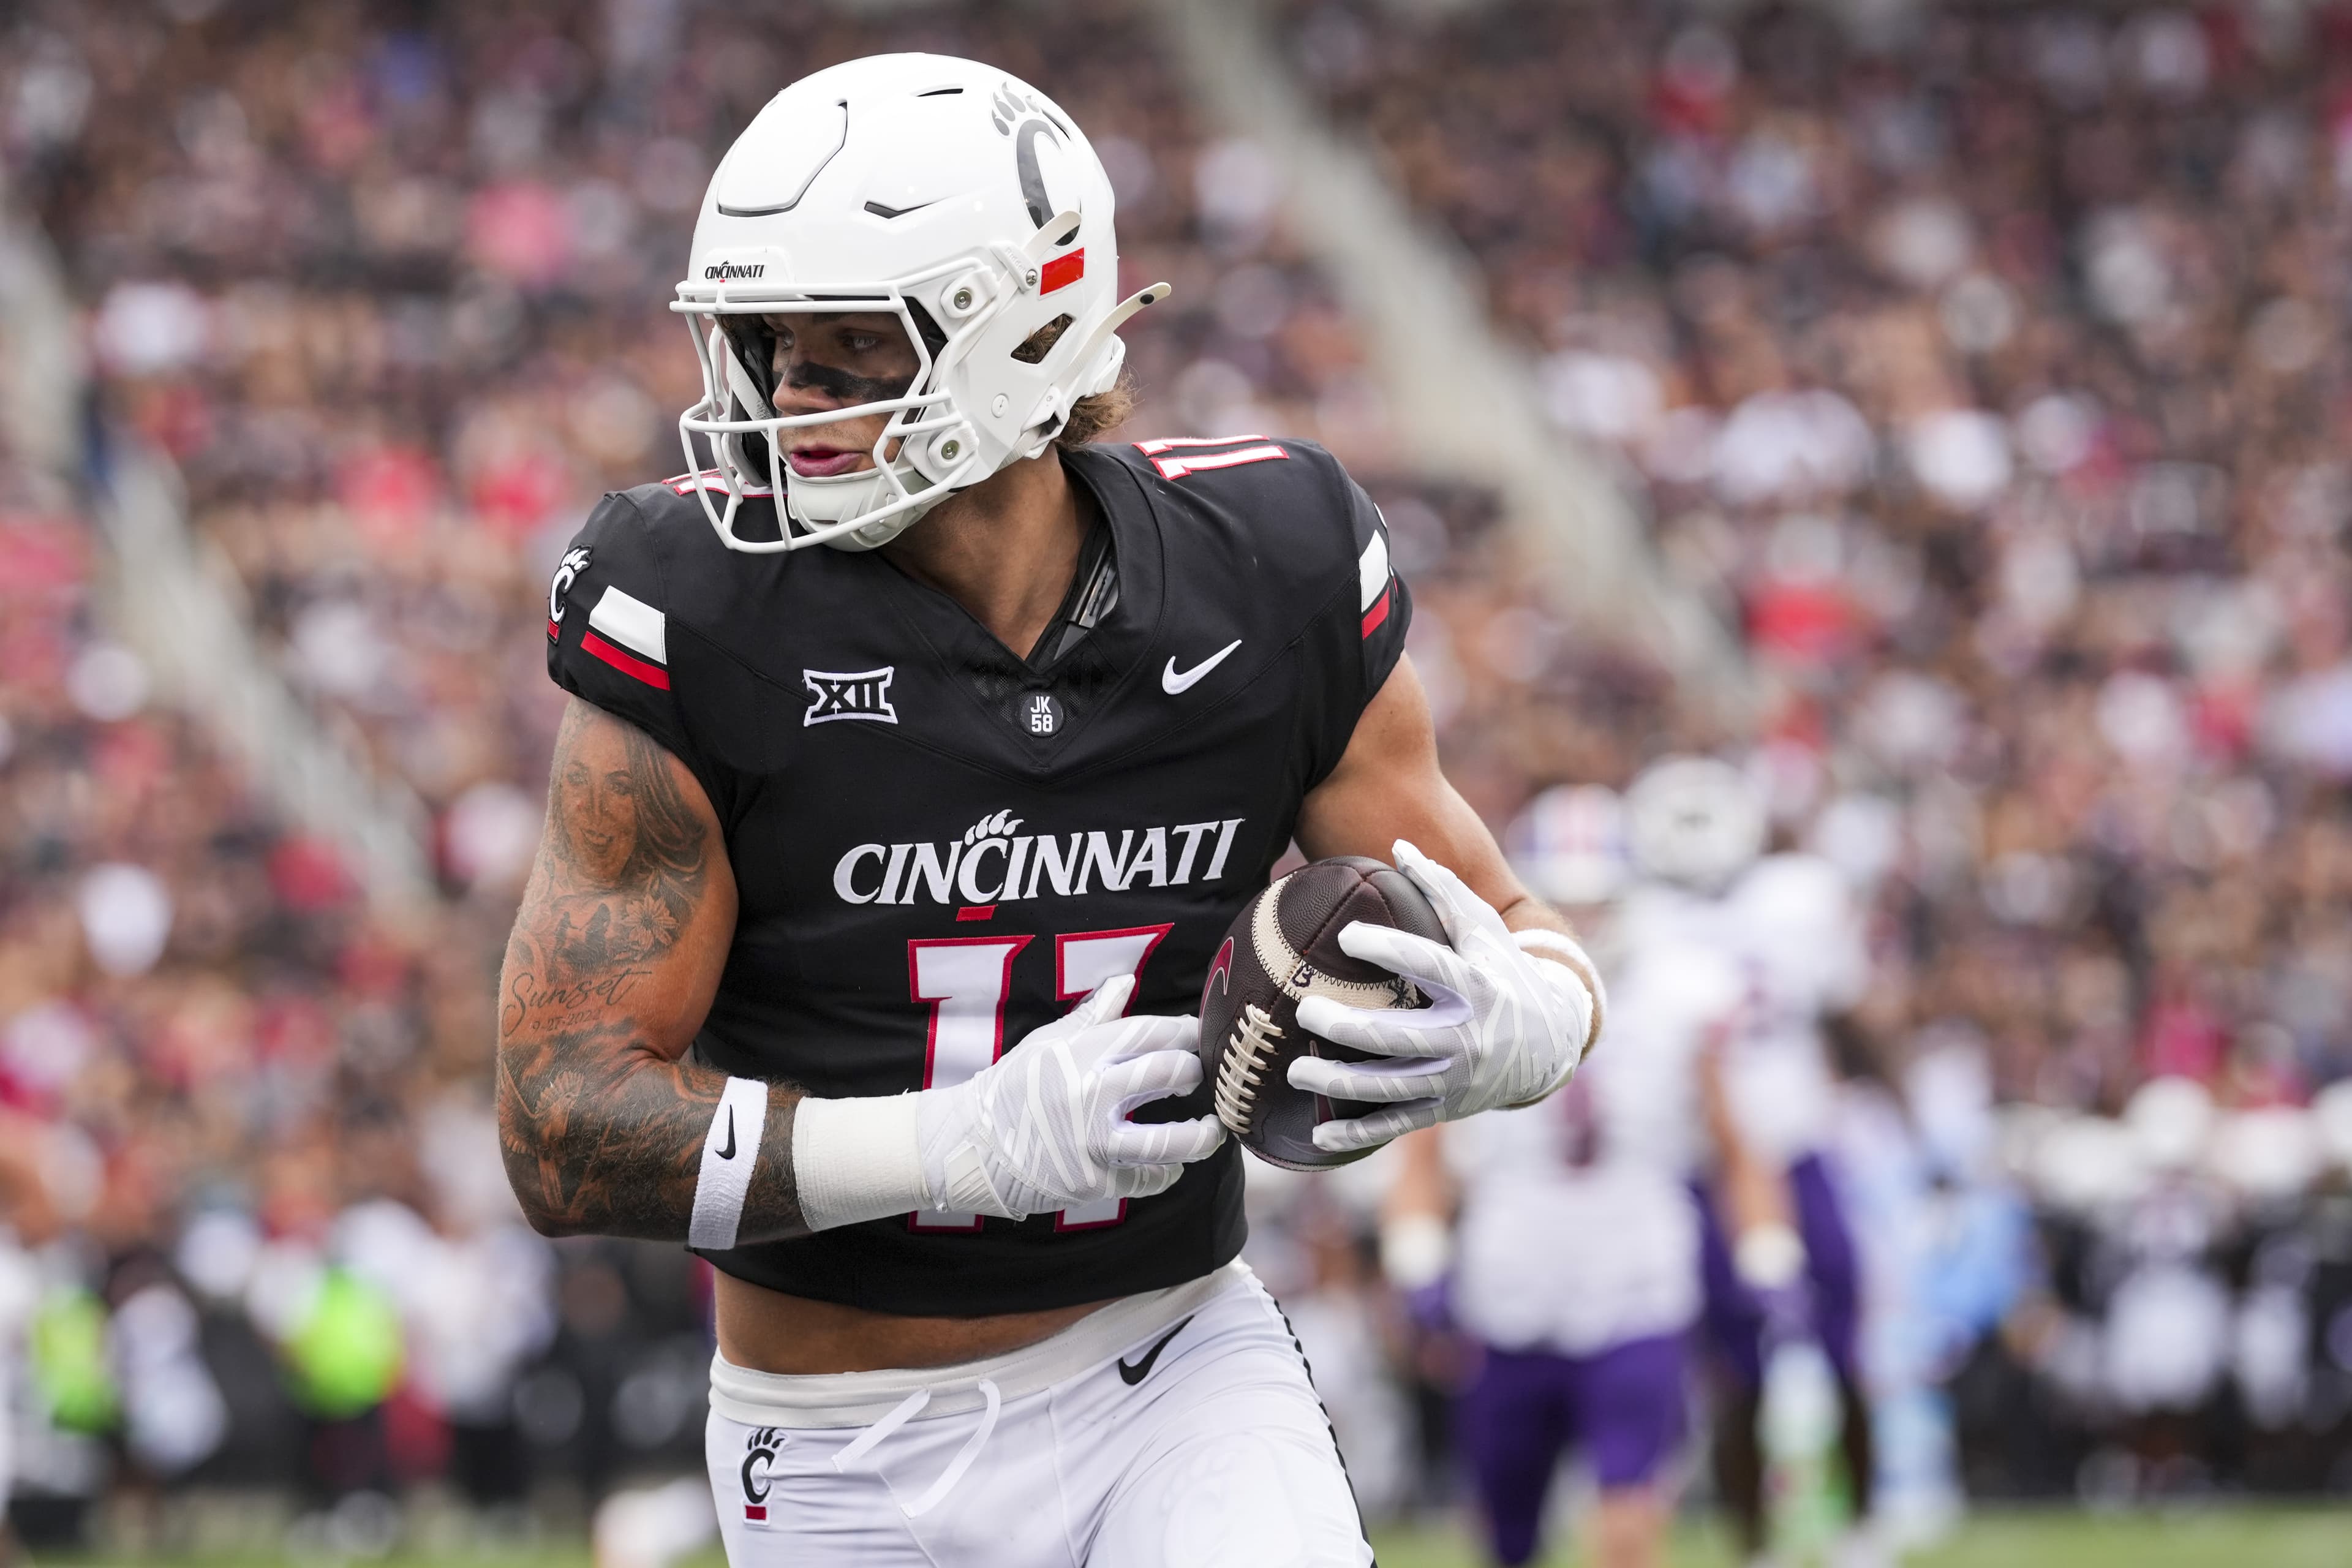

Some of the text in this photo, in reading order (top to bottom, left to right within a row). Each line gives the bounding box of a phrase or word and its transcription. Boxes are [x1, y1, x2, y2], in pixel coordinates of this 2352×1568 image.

[704, 263, 765, 280] CINCINNATI
[1131, 434, 1289, 481] 11
[804, 666, 898, 726] XII
[1030, 696, 1052, 714] JK
[1031, 714, 1053, 733] 58
[833, 818, 1246, 905] CINCINNATI
[502, 967, 652, 1037] Sunset
